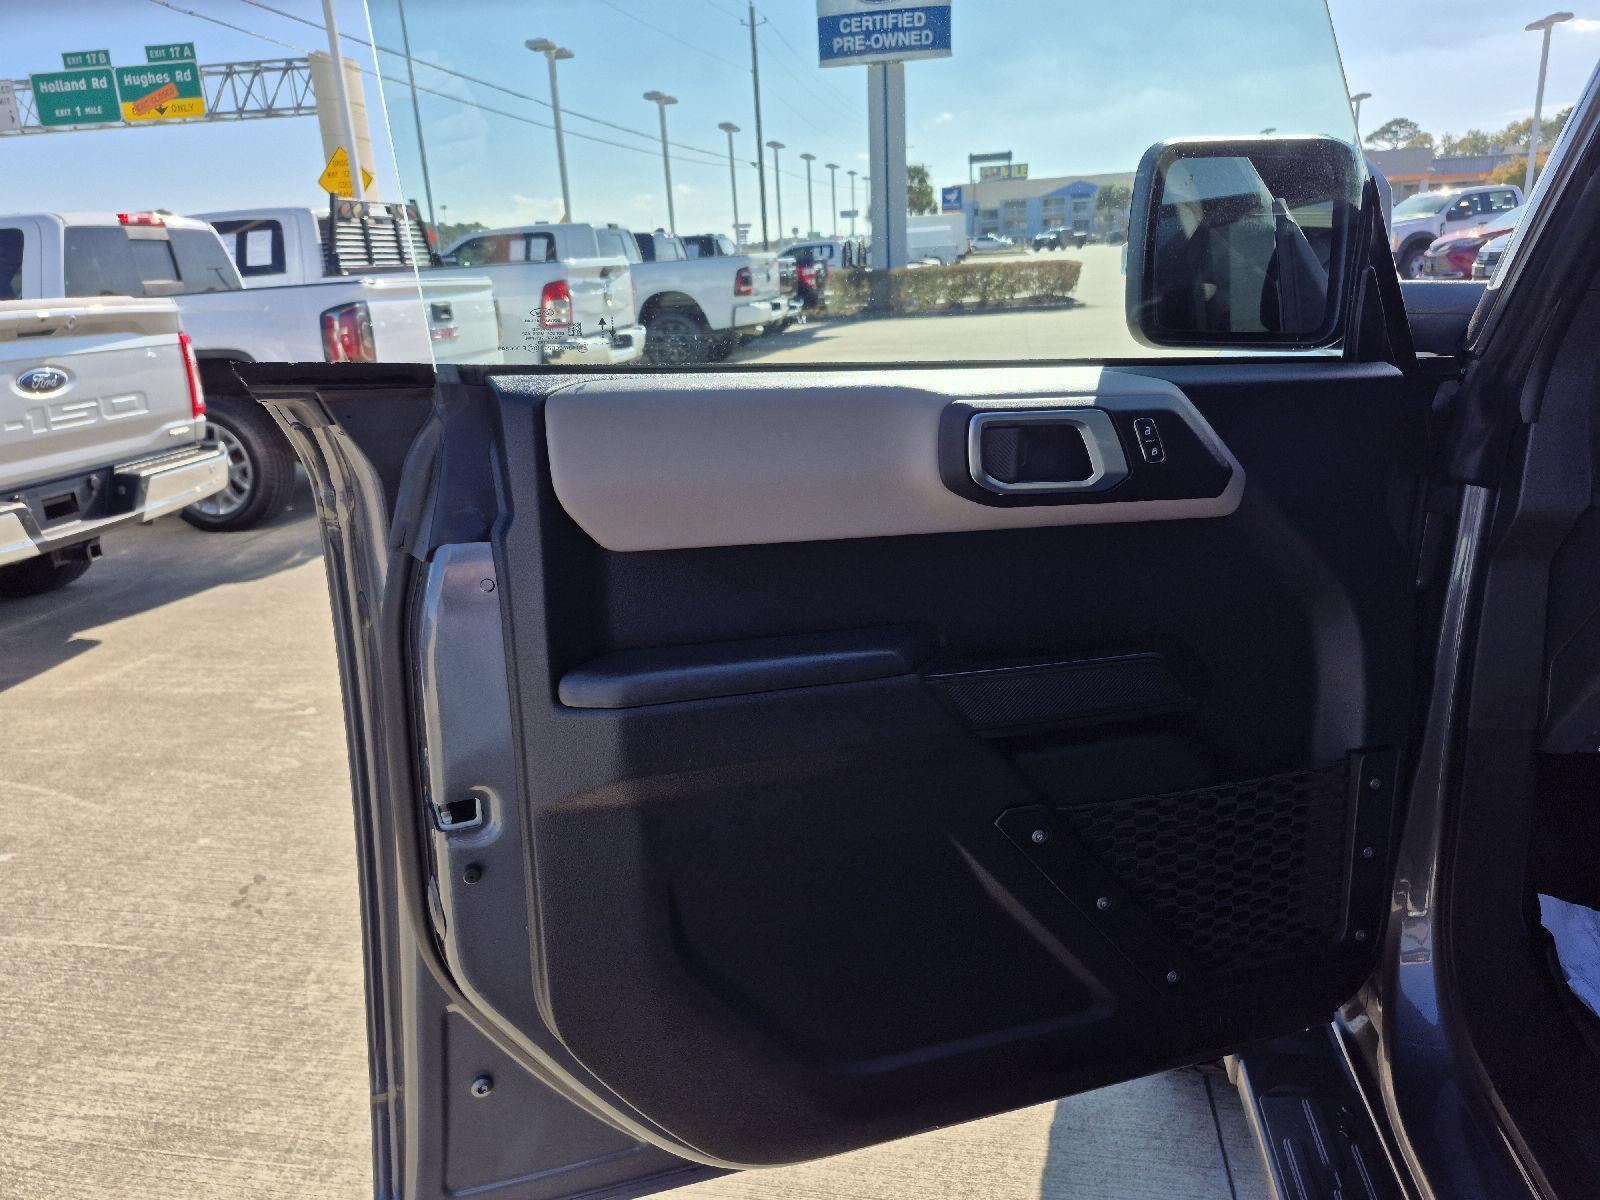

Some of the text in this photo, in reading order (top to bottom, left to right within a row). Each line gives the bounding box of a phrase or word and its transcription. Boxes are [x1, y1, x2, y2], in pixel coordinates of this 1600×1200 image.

[839, 12, 927, 34] CERTIFIED
[832, 30, 934, 54] PRE-OWNED
[66, 55, 82, 65] EXIT
[86, 53, 97, 64] 17
[149, 46, 192, 58] EXIT 17 A
[39, 76, 108, 93] Holland Rd
[123, 69, 192, 88] Hughes Rd
[55, 105, 102, 117] EXIT 1 MILE
[171, 103, 195, 113] ONLY
[31, 373, 59, 389] Ford
